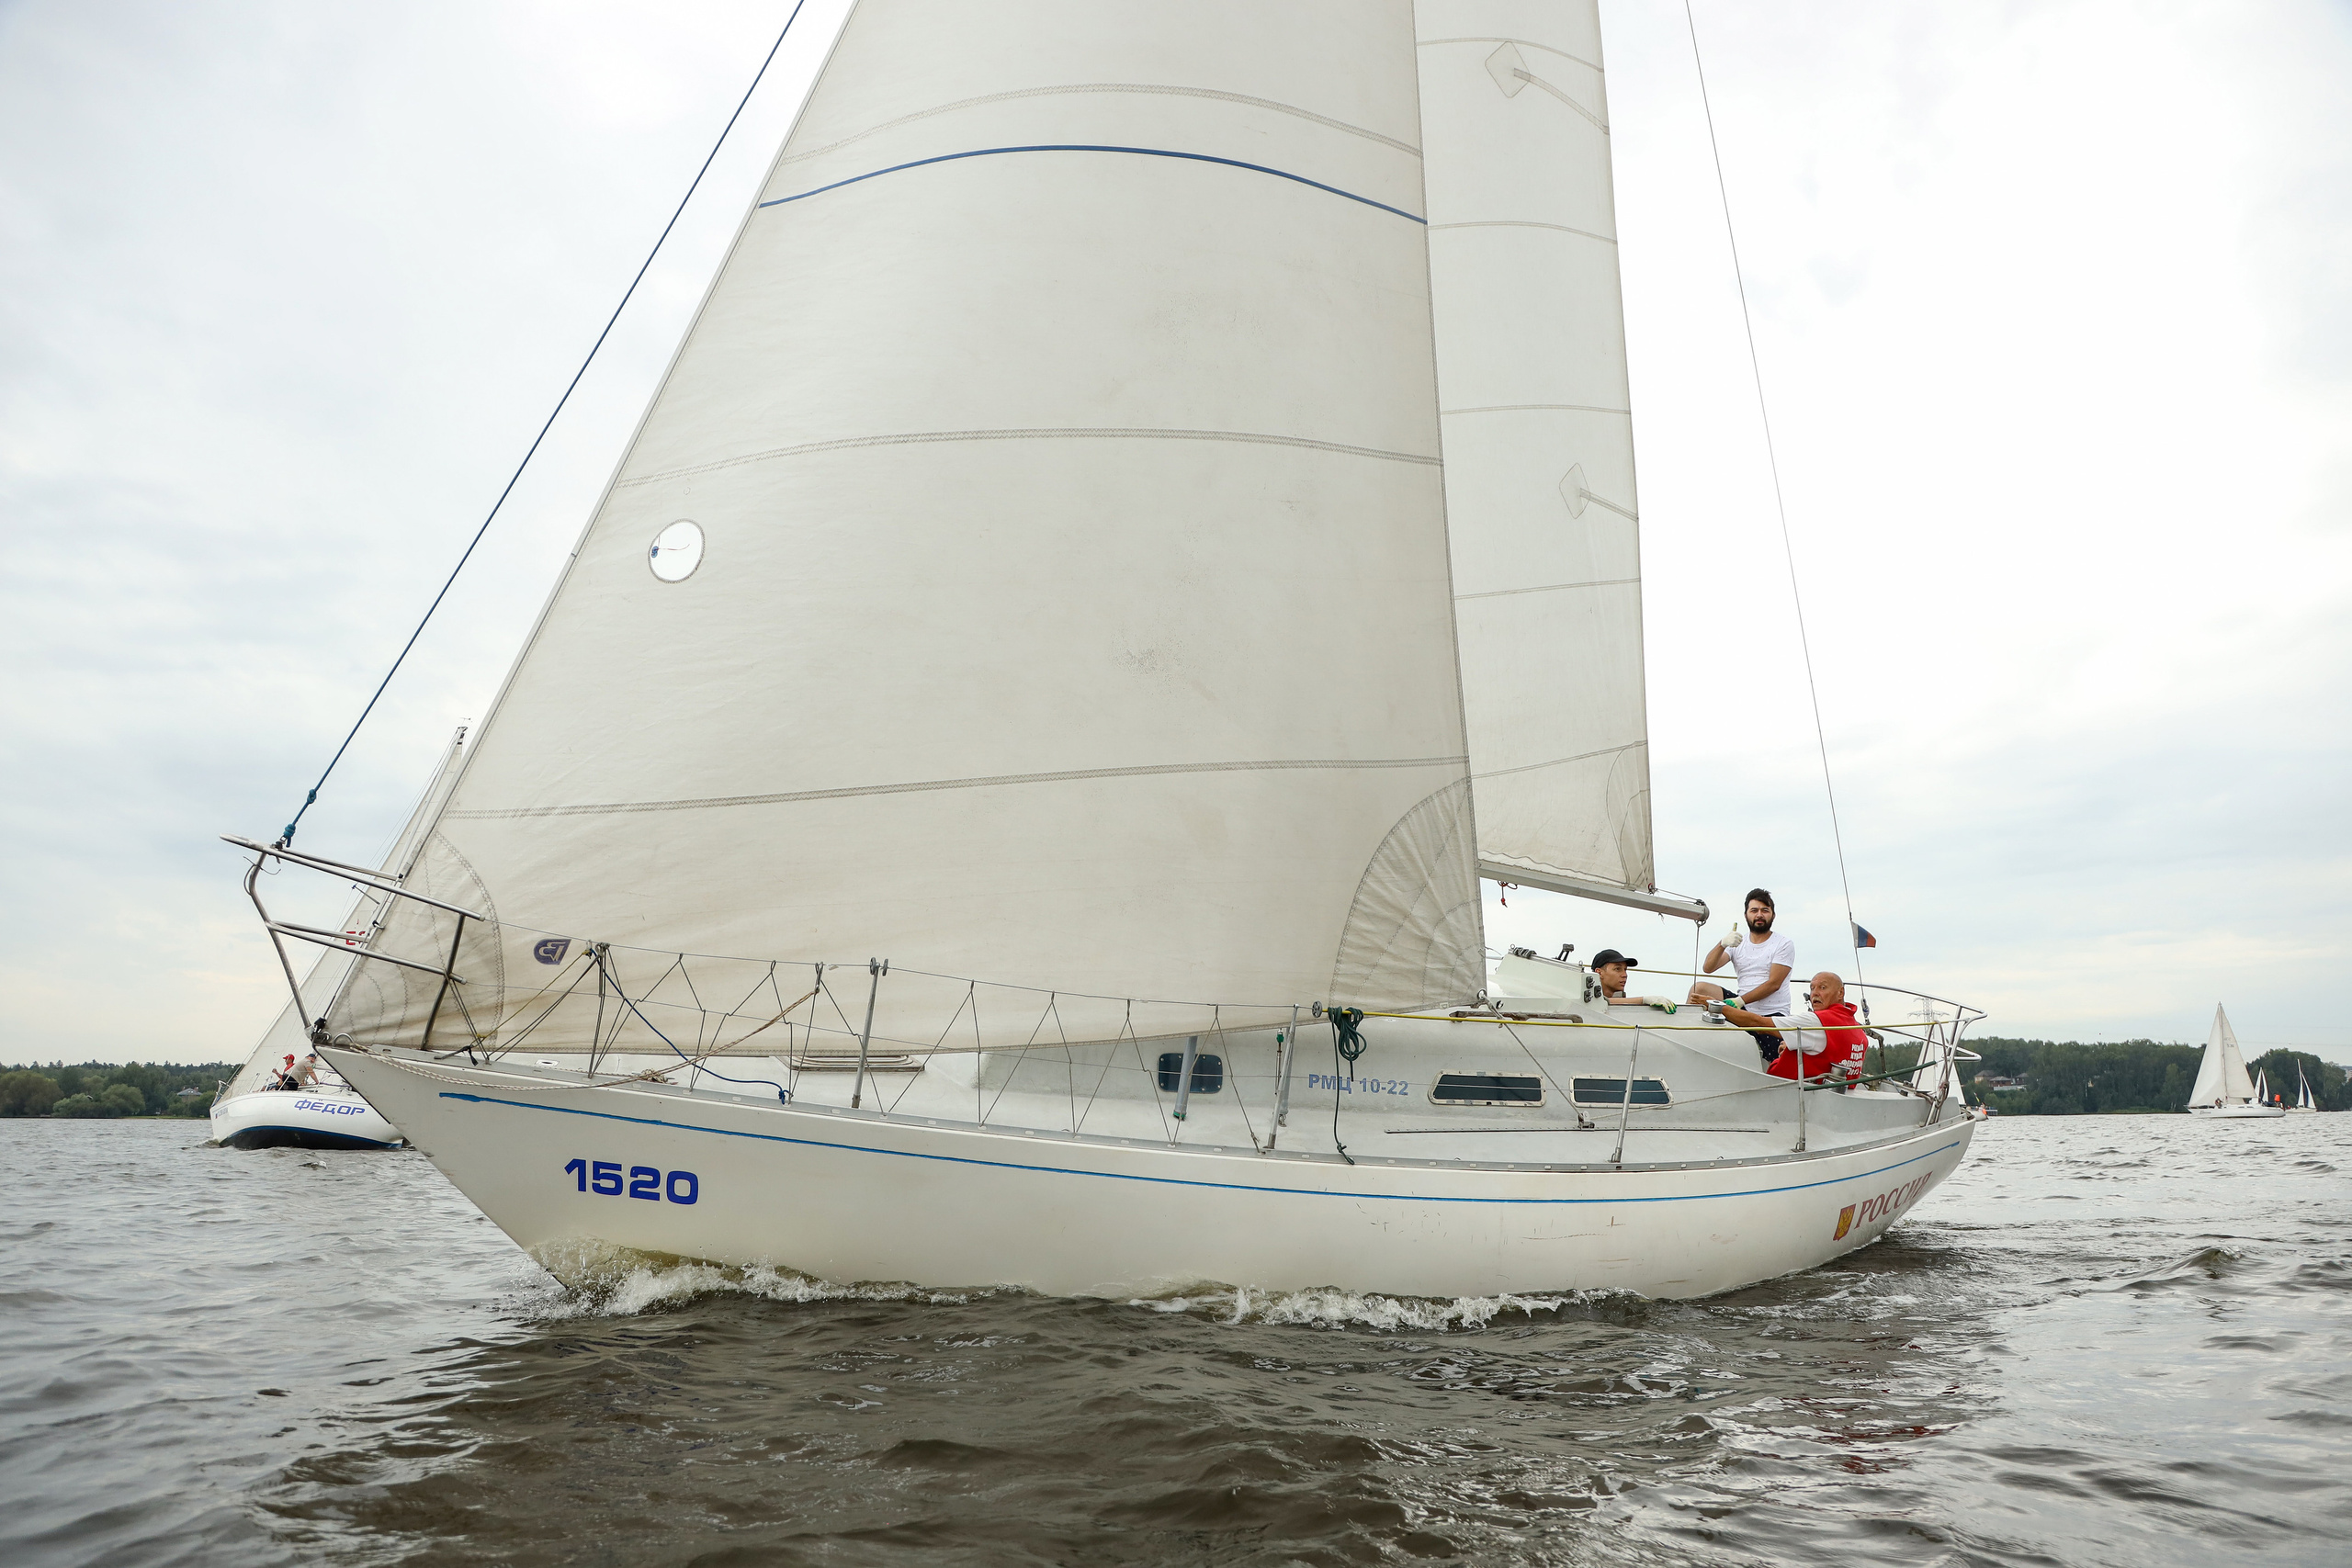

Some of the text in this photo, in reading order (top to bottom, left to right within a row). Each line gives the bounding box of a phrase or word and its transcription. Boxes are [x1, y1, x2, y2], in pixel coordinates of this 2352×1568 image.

[1308, 1074, 1408, 1095] РМЦ 10-22
[294, 1099, 366, 1115] ФЁДОР
[564, 1158, 699, 1205] 1520
[1854, 1171, 1933, 1229] РОССИЯ
